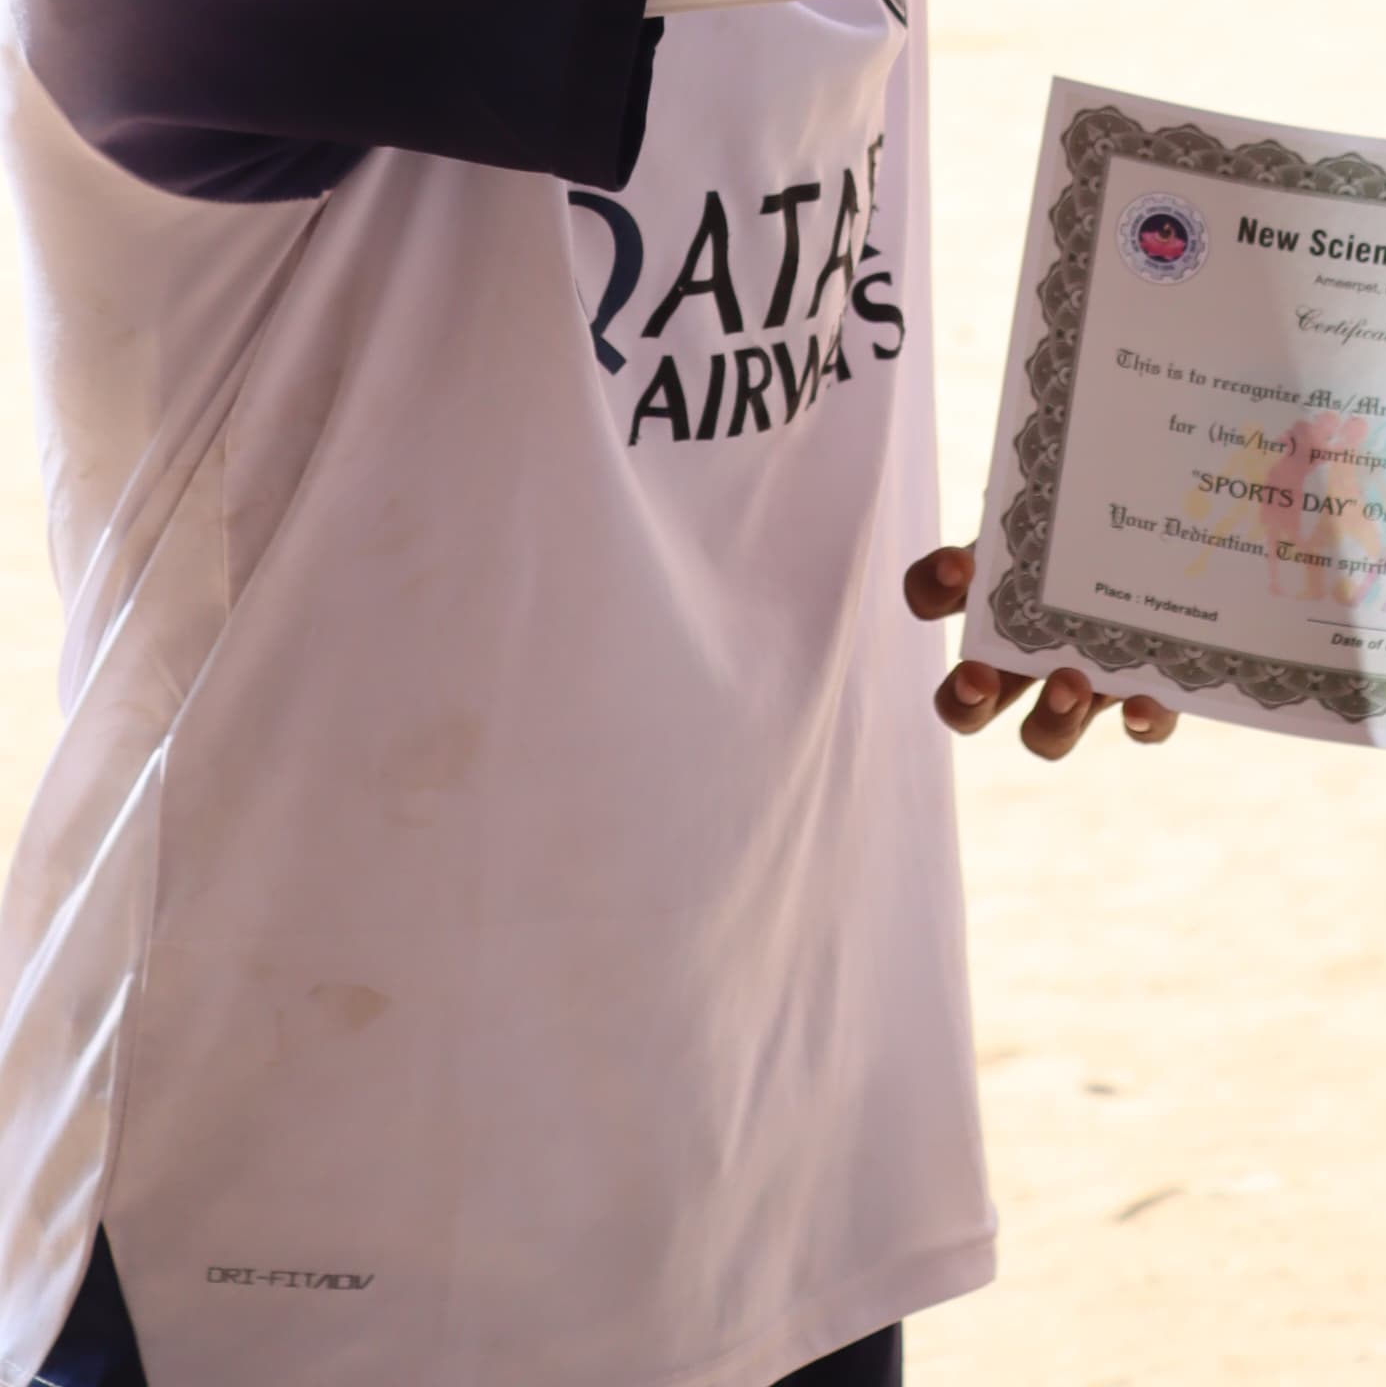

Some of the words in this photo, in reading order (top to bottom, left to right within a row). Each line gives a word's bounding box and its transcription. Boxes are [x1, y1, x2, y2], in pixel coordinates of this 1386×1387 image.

[1237, 216, 1300, 252] New
[628, 271, 905, 447] AIRWAS
[1116, 348, 1161, 377] This
[1167, 362, 1183, 380] is
[1190, 369, 1206, 386] to
[1213, 377, 1300, 403] recognize
[1168, 414, 1196, 435] for
[1208, 423, 1297, 457] (his/her)
[1191, 469, 1295, 508] "SPORTS
[1109, 503, 1157, 534] Your
[1276, 541, 1332, 568] Team
[1095, 582, 1131, 602] Place
[1144, 594, 1219, 622] Hyderabad
[1331, 632, 1363, 649] Date
[1367, 638, 1384, 650] of
